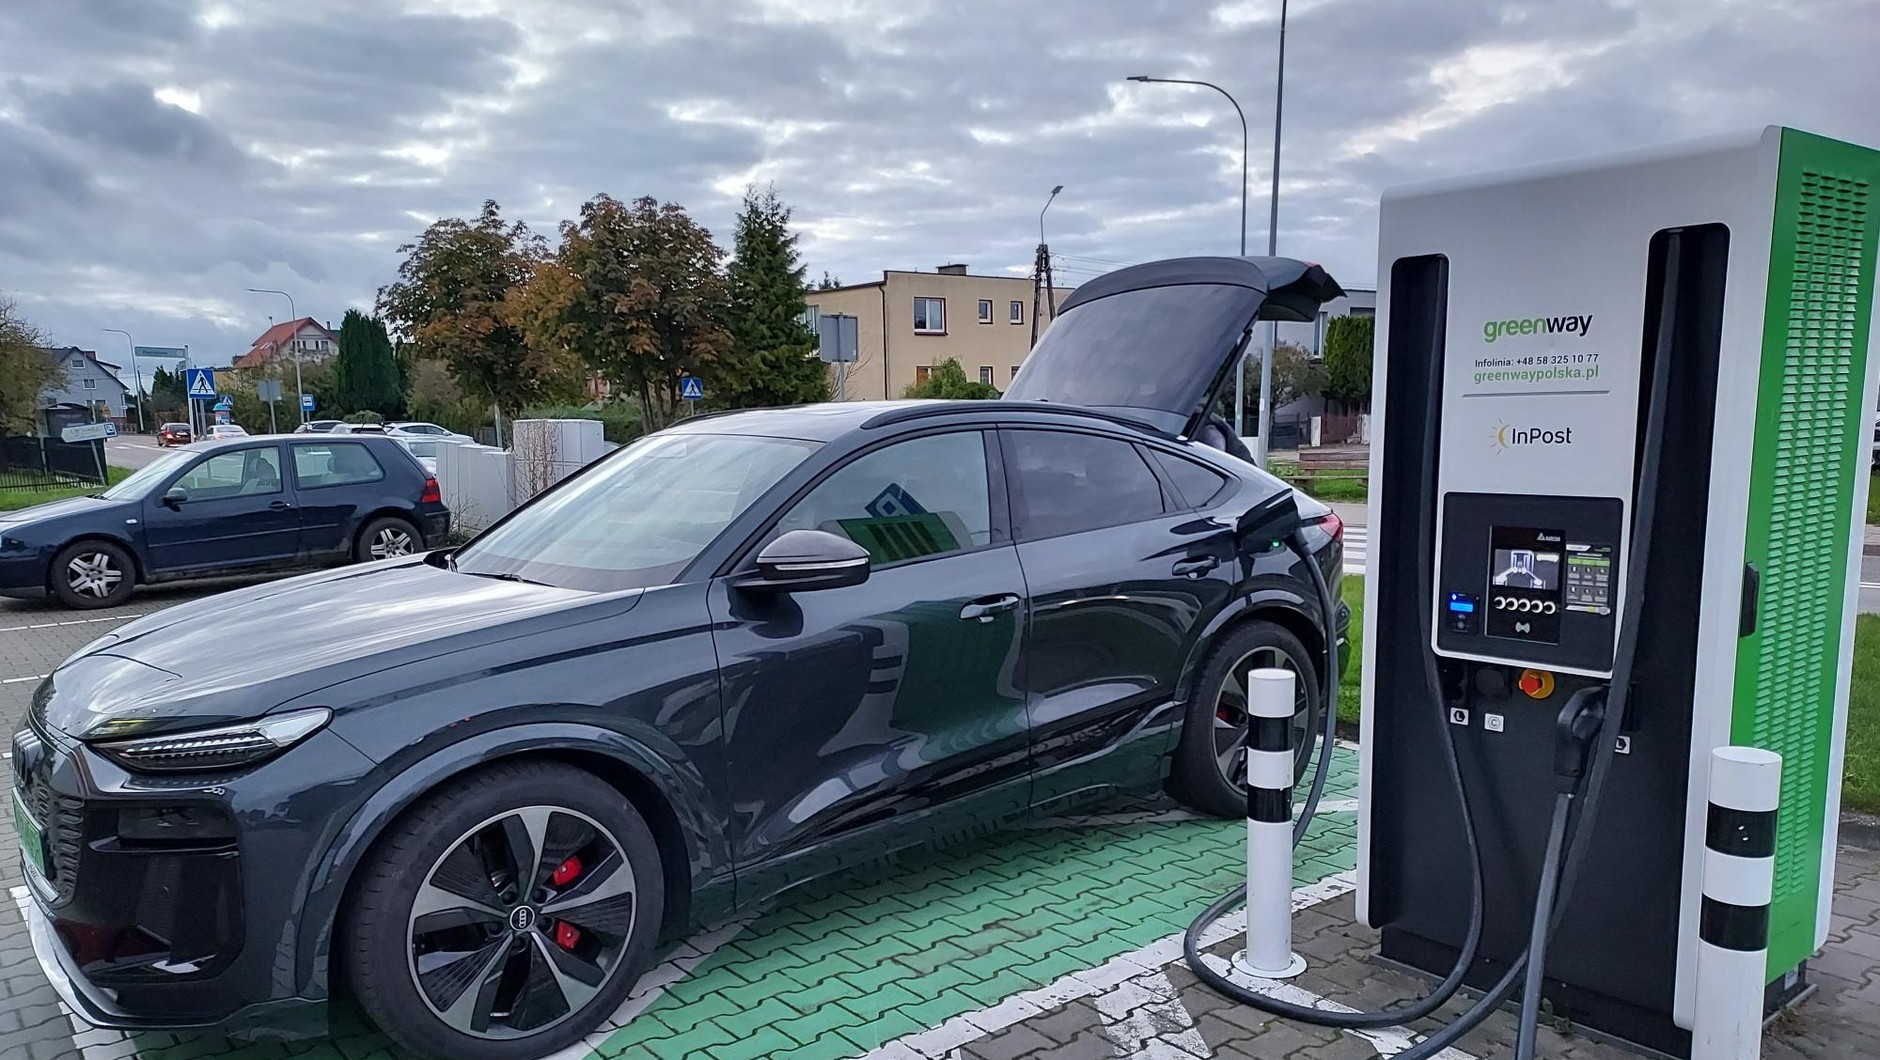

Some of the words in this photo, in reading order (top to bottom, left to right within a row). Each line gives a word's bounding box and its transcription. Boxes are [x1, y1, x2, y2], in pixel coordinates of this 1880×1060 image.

[1483, 314, 1593, 343] greenway
[1474, 359, 1514, 368] Infolinia:
[1516, 356, 1534, 366] +48
[1536, 356, 1548, 365] 58
[1550, 355, 1569, 364] 325
[1572, 354, 1584, 364] 10
[1587, 353, 1599, 363] 77
[1474, 365, 1599, 385] greenwaypolska.pl
[1511, 427, 1572, 445] InPost
